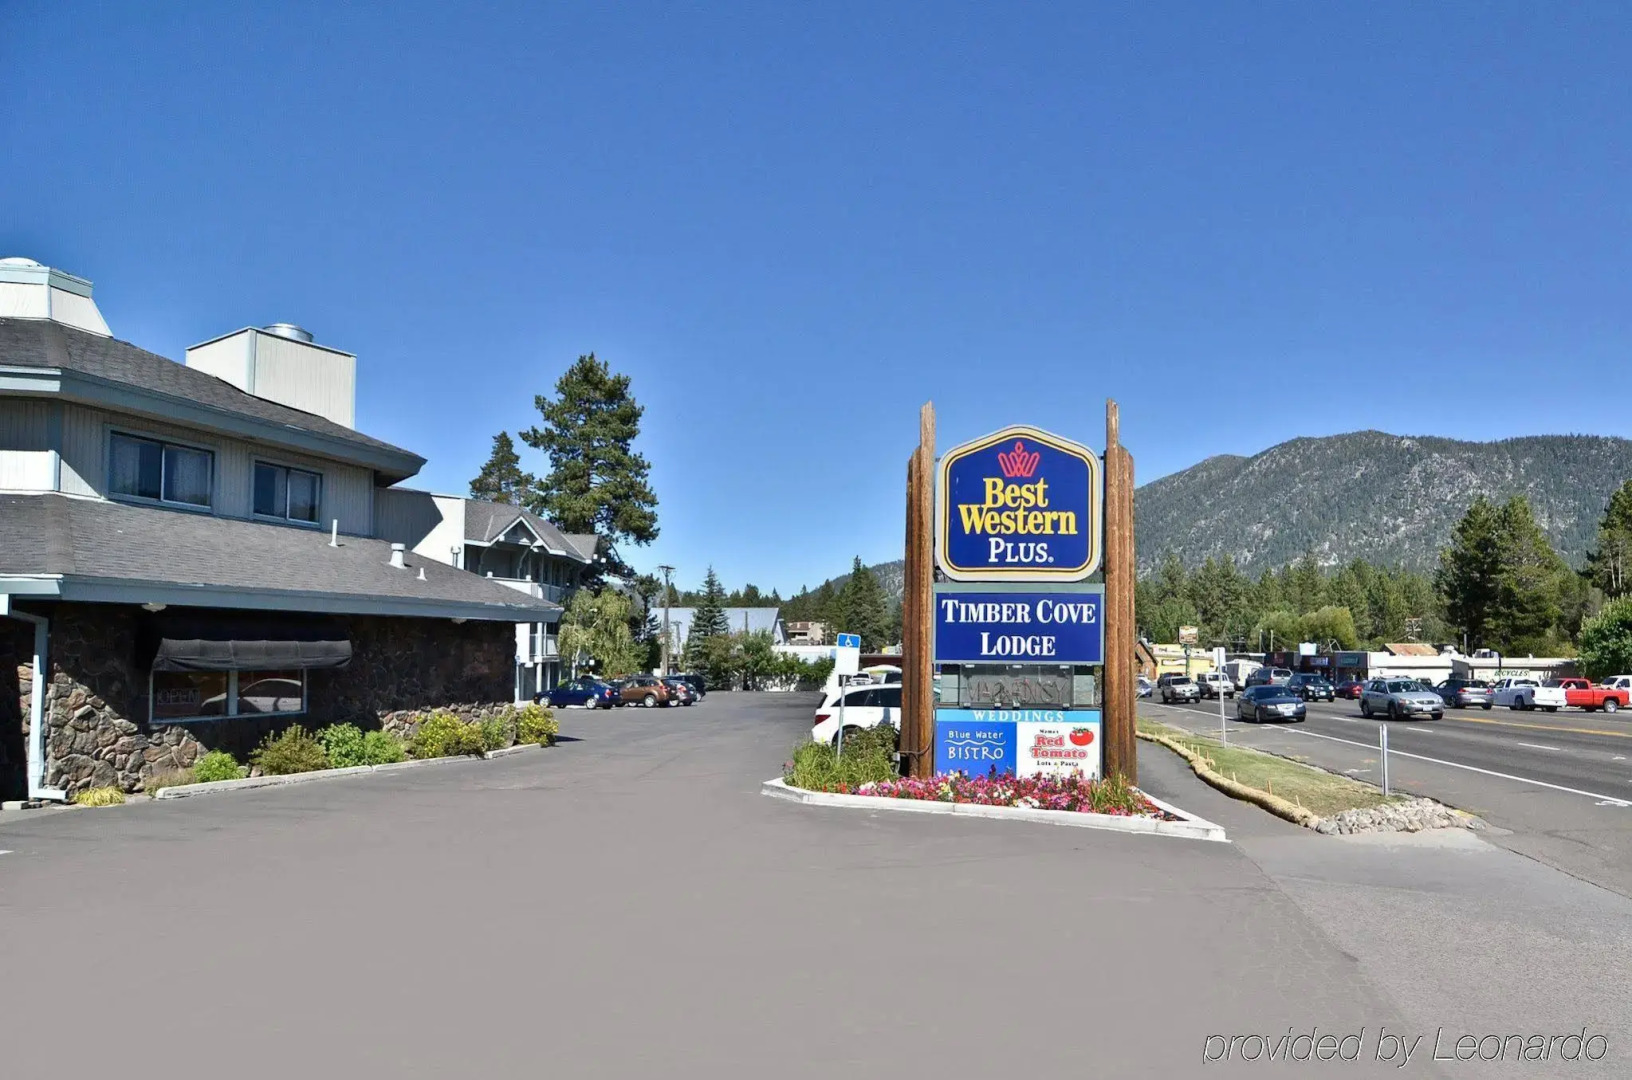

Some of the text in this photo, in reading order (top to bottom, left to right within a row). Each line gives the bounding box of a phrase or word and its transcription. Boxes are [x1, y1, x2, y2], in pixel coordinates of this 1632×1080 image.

[983, 477, 1048, 507] Best
[958, 504, 1077, 535] Western
[941, 599, 1096, 624] TIMBER COVE
[980, 632, 1056, 656] LODGE
[973, 710, 1064, 721] WEDDINGS
[948, 730, 1003, 739] Blue Water
[1035, 734, 1065, 747] Red
[948, 746, 1004, 760] BISTRO
[1030, 746, 1088, 759] Tomato
